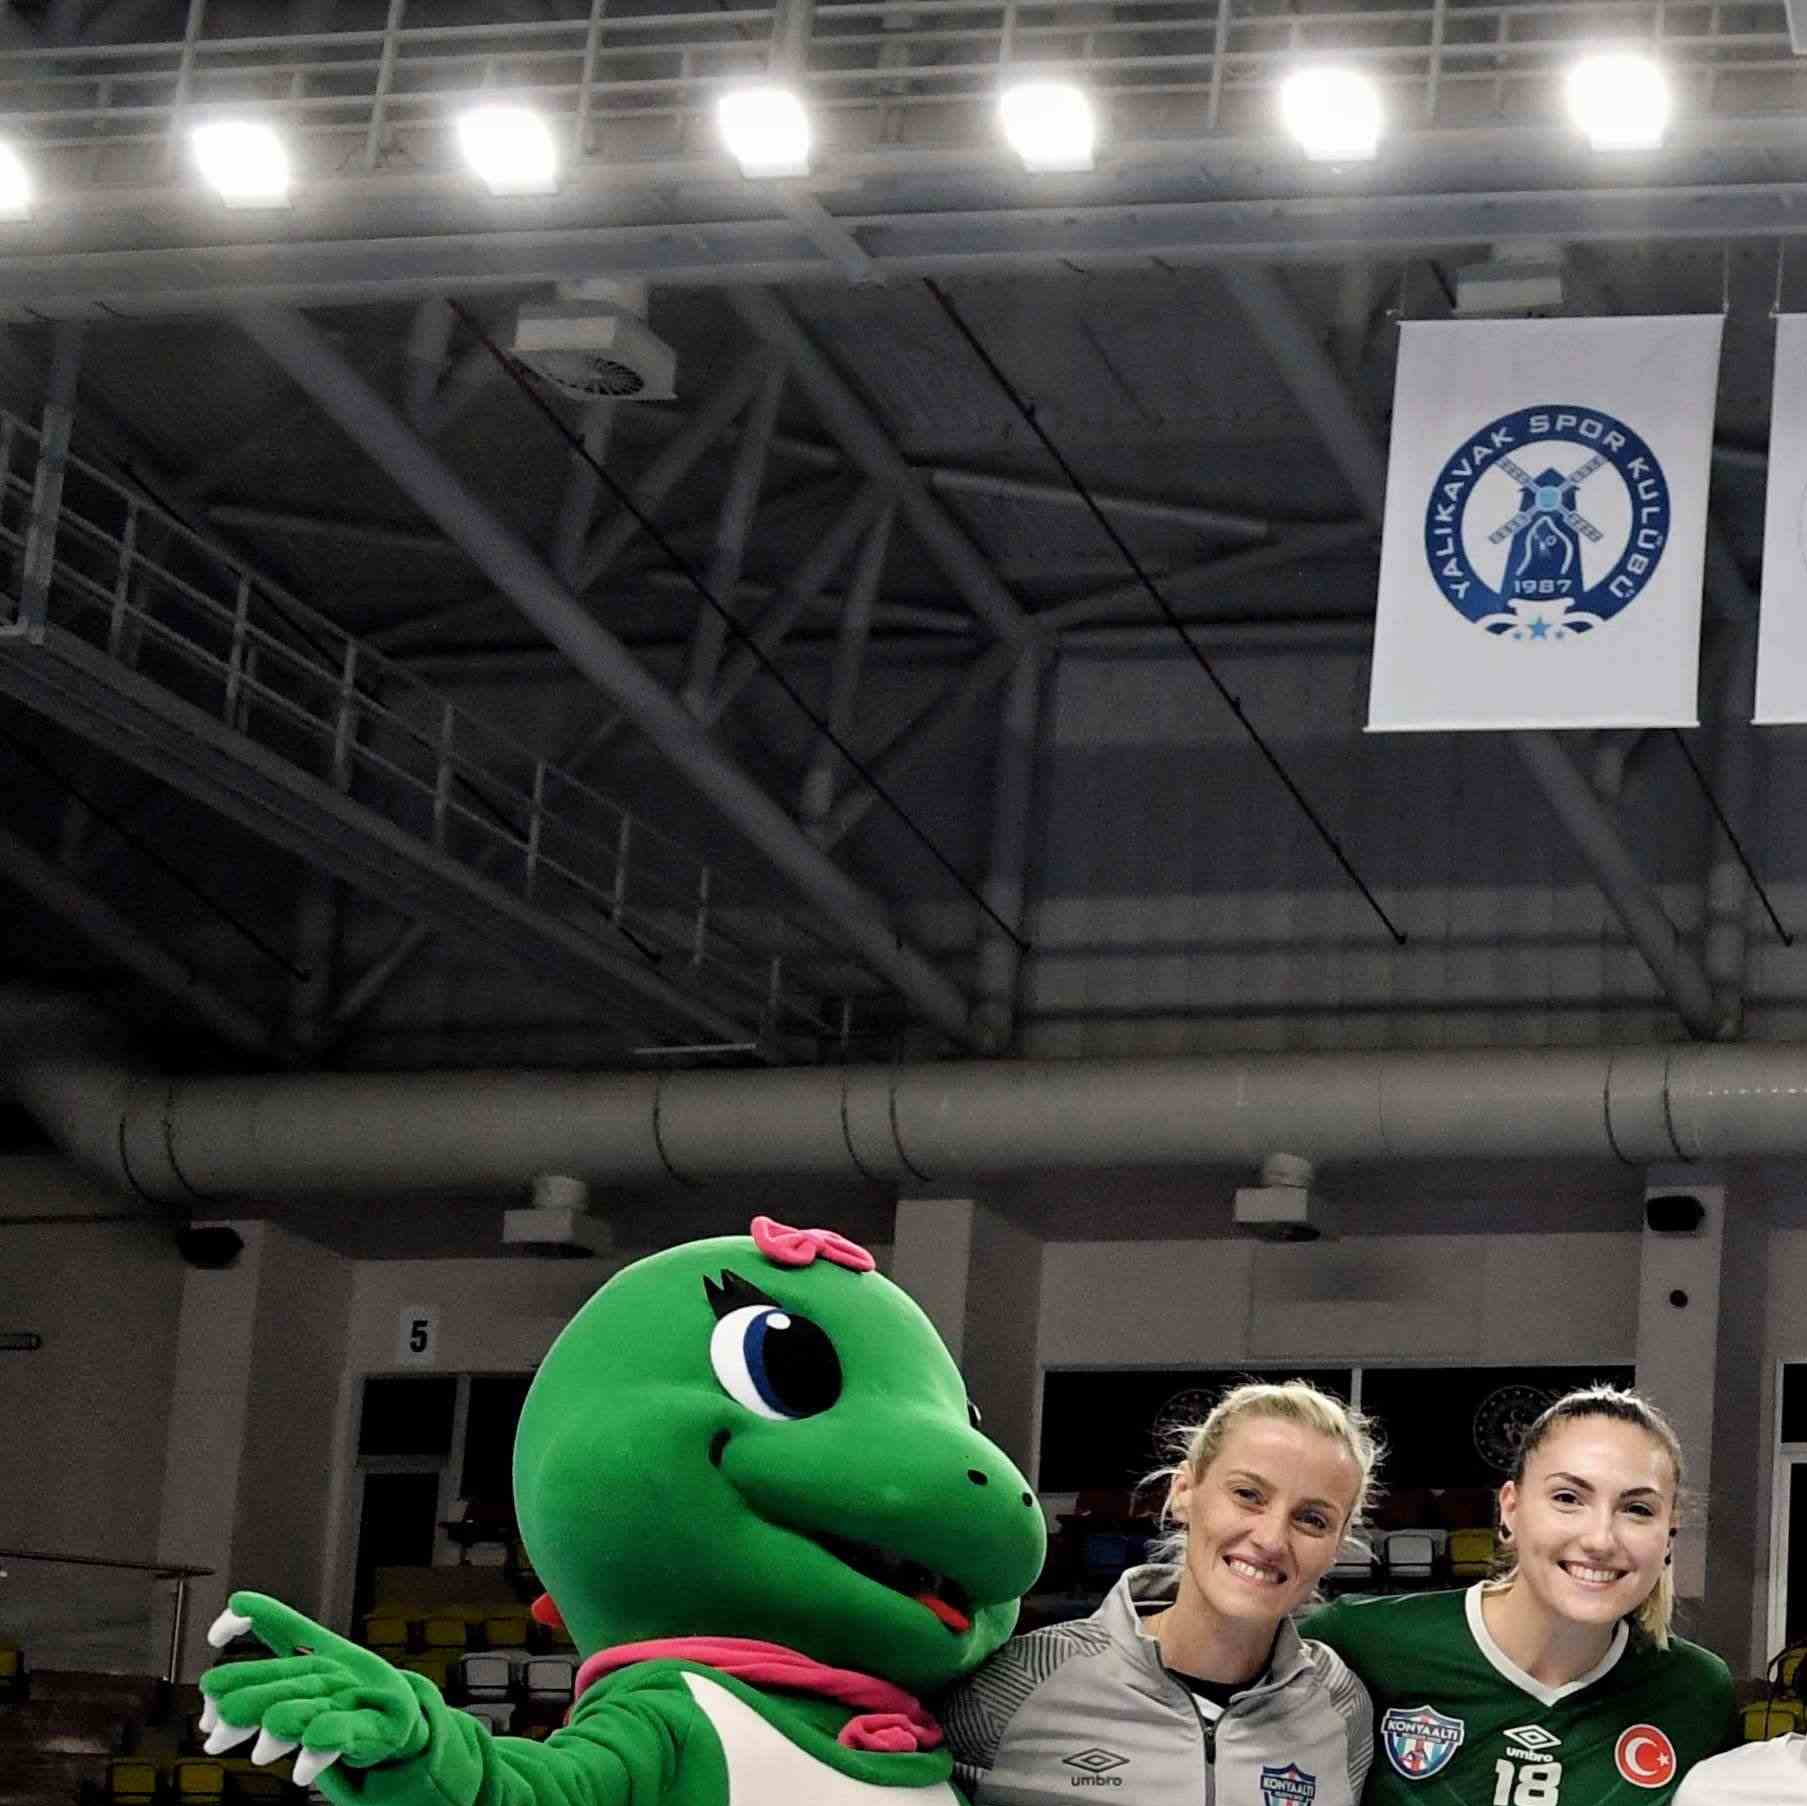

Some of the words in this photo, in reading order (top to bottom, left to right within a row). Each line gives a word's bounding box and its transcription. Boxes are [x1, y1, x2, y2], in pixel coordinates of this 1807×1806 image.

[1434, 426, 1514, 600] YALIKAVAK
[1529, 414, 1626, 452] SPOR
[1609, 456, 1663, 599] KULÜBÜ
[1514, 579, 1572, 594] 1987
[410, 1320, 428, 1354] 5
[1387, 1719, 1458, 1740] KONYAALTI
[1506, 1746, 1553, 1763] umbro
[1071, 1774, 1122, 1787] umbro
